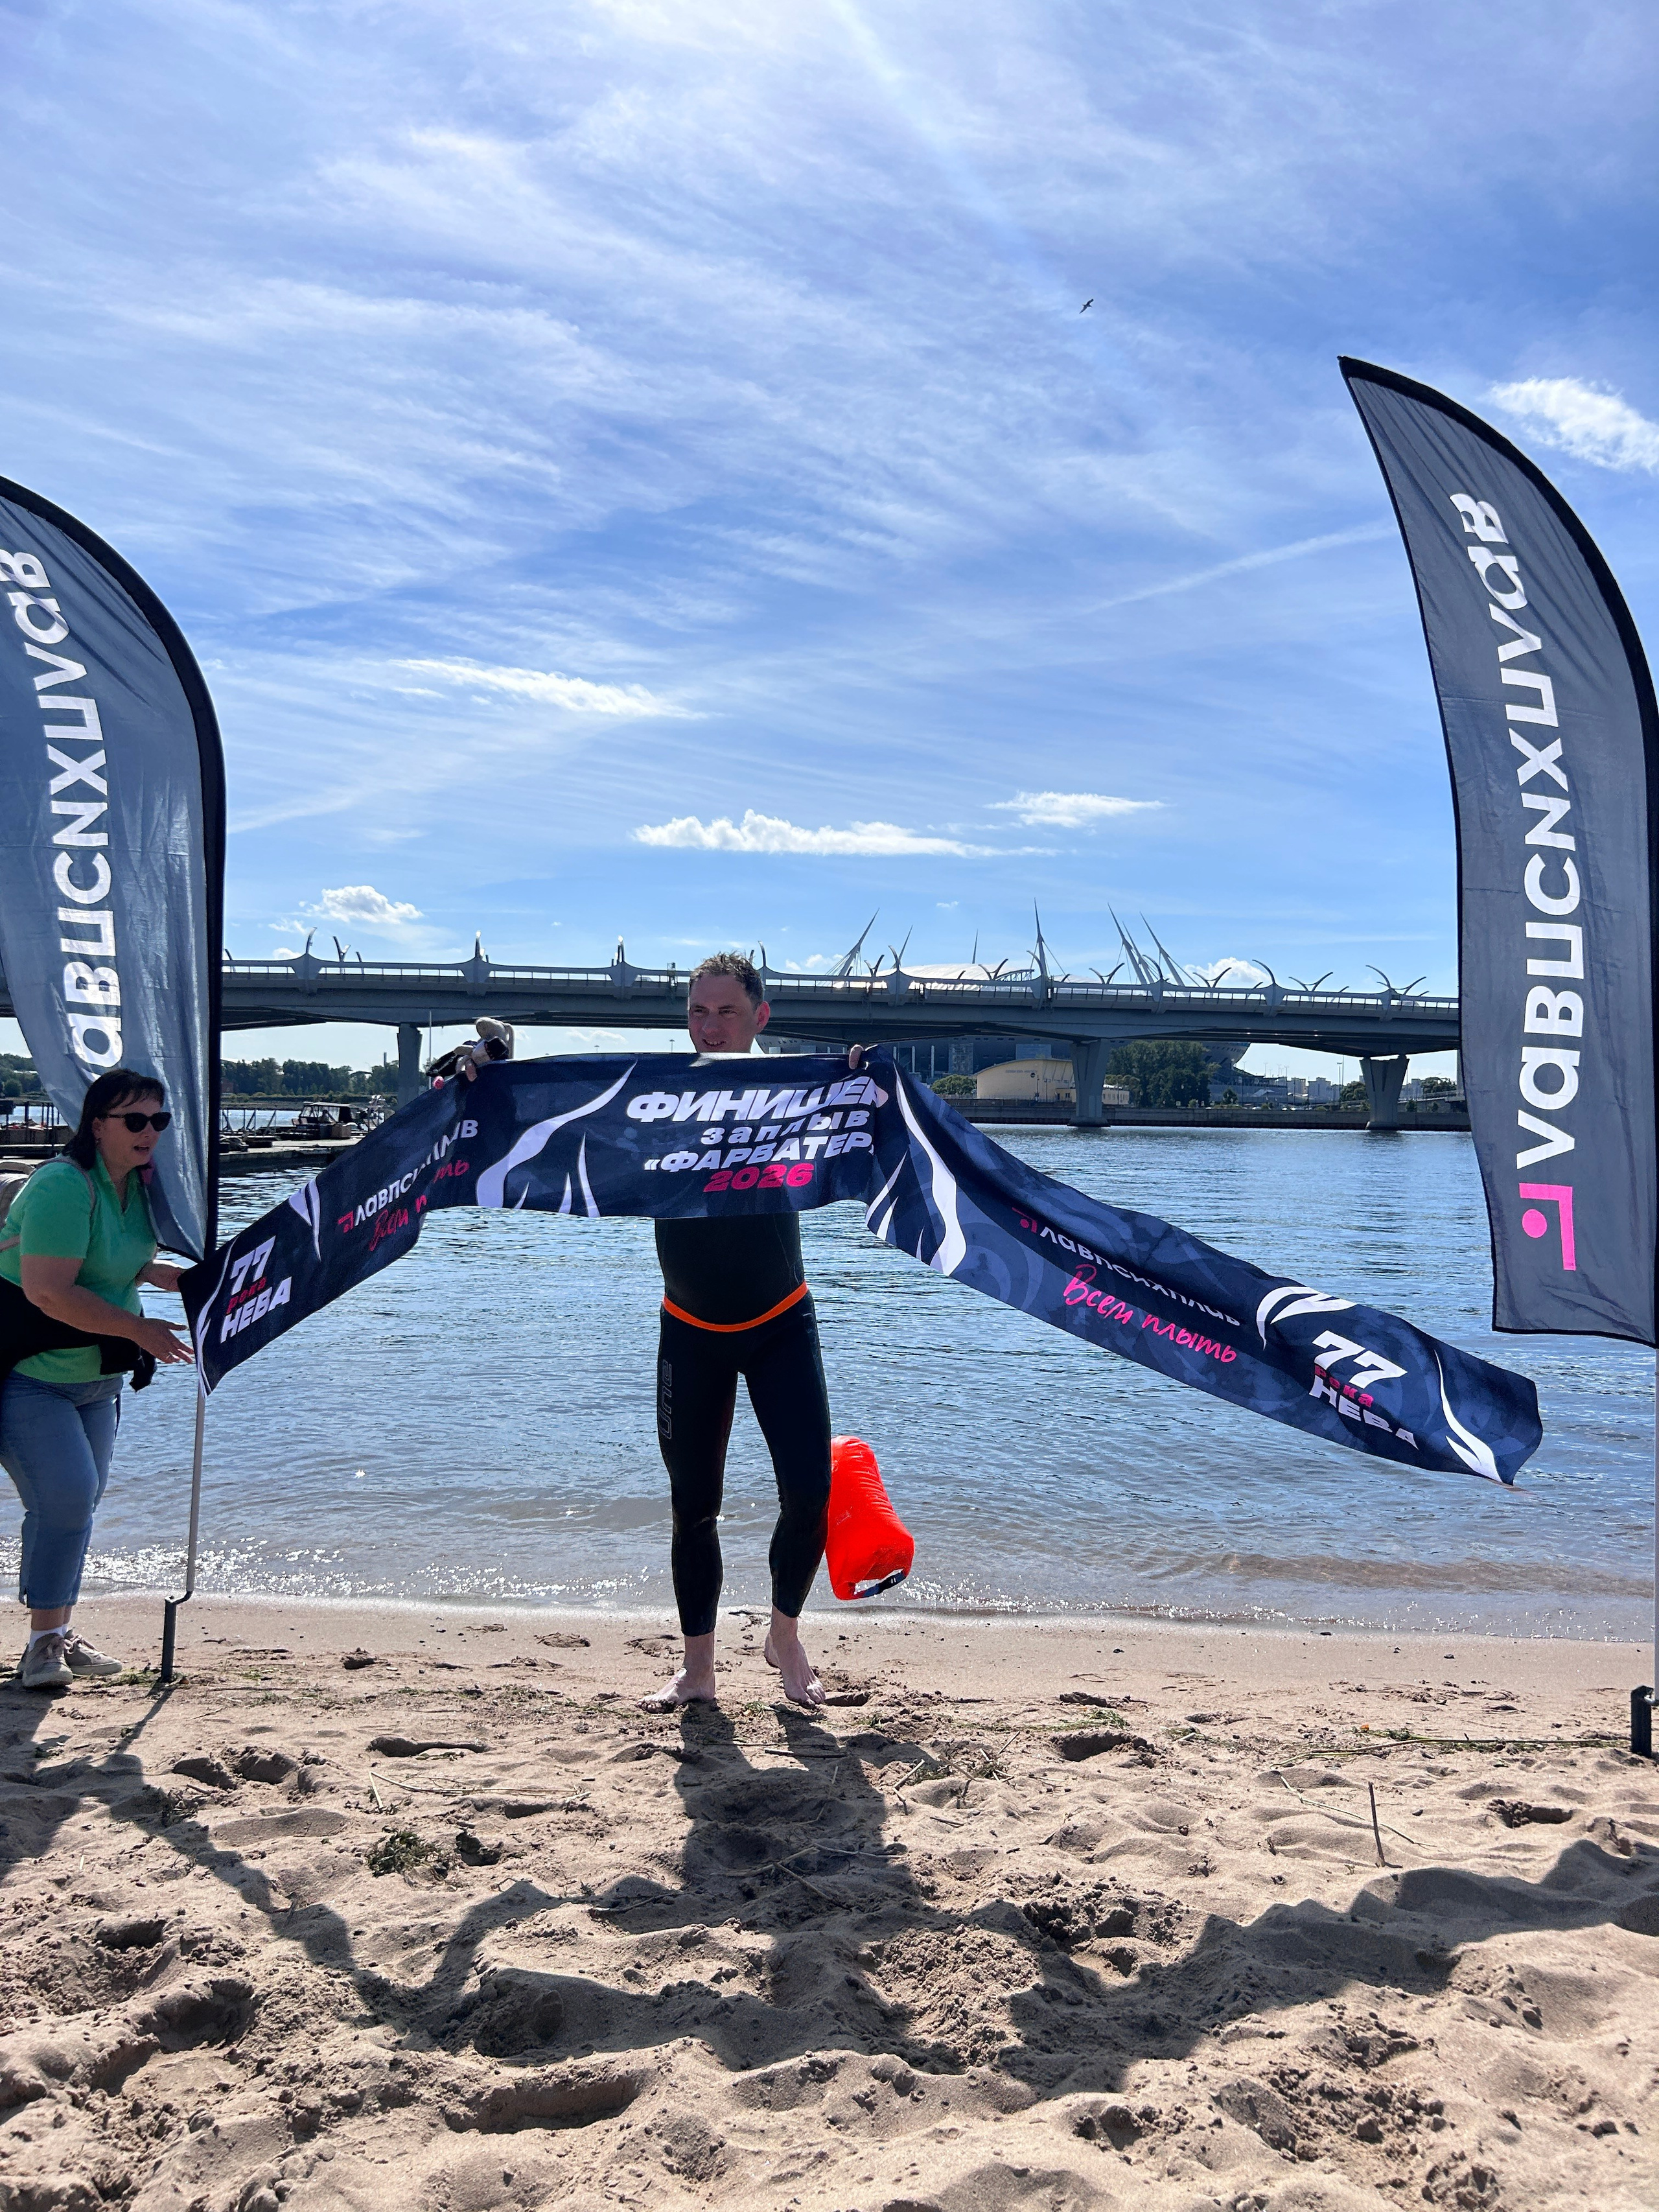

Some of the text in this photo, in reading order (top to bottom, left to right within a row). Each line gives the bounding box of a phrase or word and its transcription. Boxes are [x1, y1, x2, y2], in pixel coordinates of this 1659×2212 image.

[703, 1163, 815, 1192] 2026
[230, 1235, 276, 1295] 77
[220, 1276, 292, 1344] НЕВА
[1063, 1264, 1237, 1363] Всем плыть
[1312, 1330, 1408, 1389] 77
